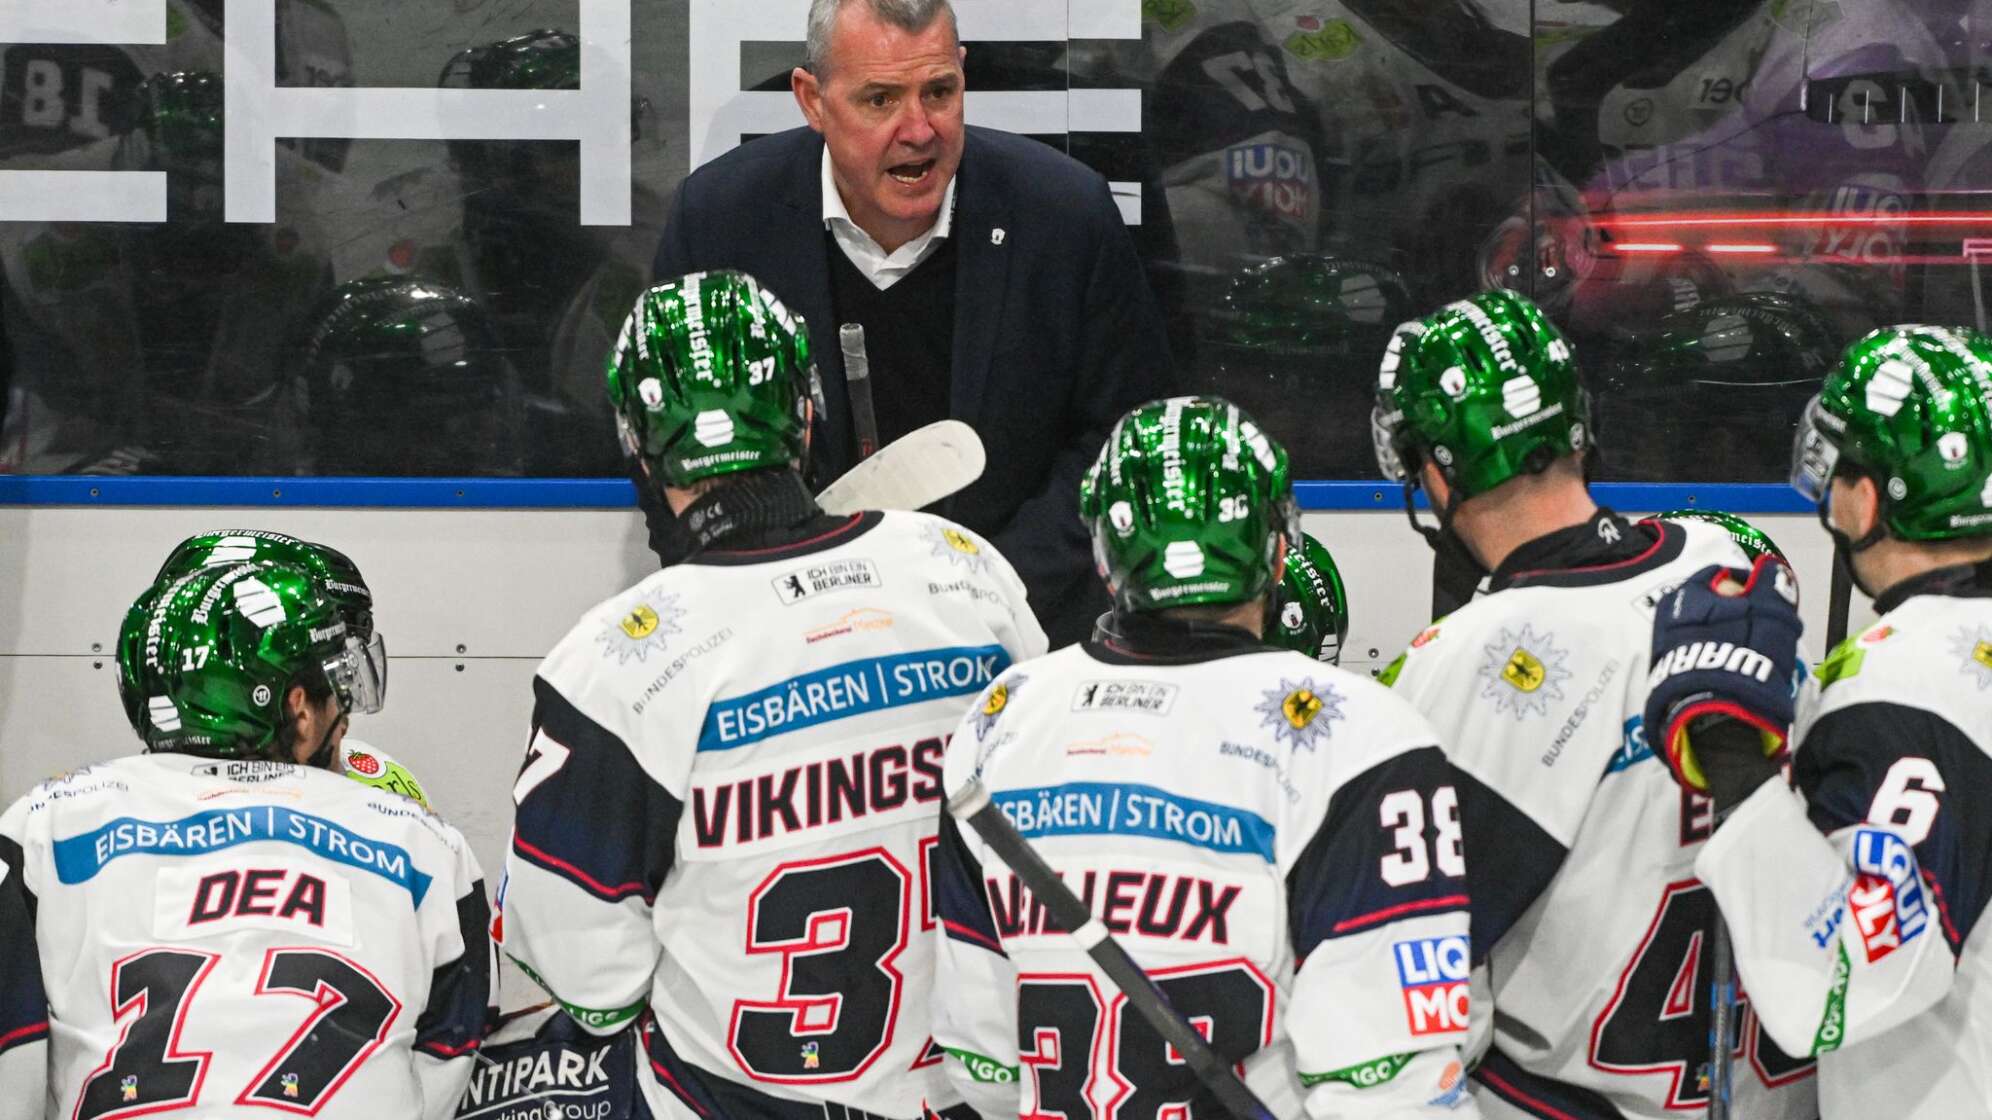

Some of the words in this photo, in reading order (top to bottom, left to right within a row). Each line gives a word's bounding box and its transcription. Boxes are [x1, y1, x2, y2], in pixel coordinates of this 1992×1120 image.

[748, 356, 776, 386] 37
[812, 572, 872, 592] BERLINER
[182, 646, 210, 672] 17
[716, 672, 870, 744] EISBÄREN
[1541, 657, 1620, 768] BUNDESPOLIZEI
[227, 763, 249, 776] ICH
[692, 734, 952, 848] VIKINGS
[95, 810, 254, 864] EISBÄREN
[288, 814, 406, 877] STROM
[993, 791, 1103, 832] SBÄREN
[1126, 797, 1243, 848] STROM
[1379, 787, 1466, 887] 38
[187, 868, 328, 929] DEA
[72, 946, 403, 1120] 17
[1018, 957, 1276, 1120] 38
